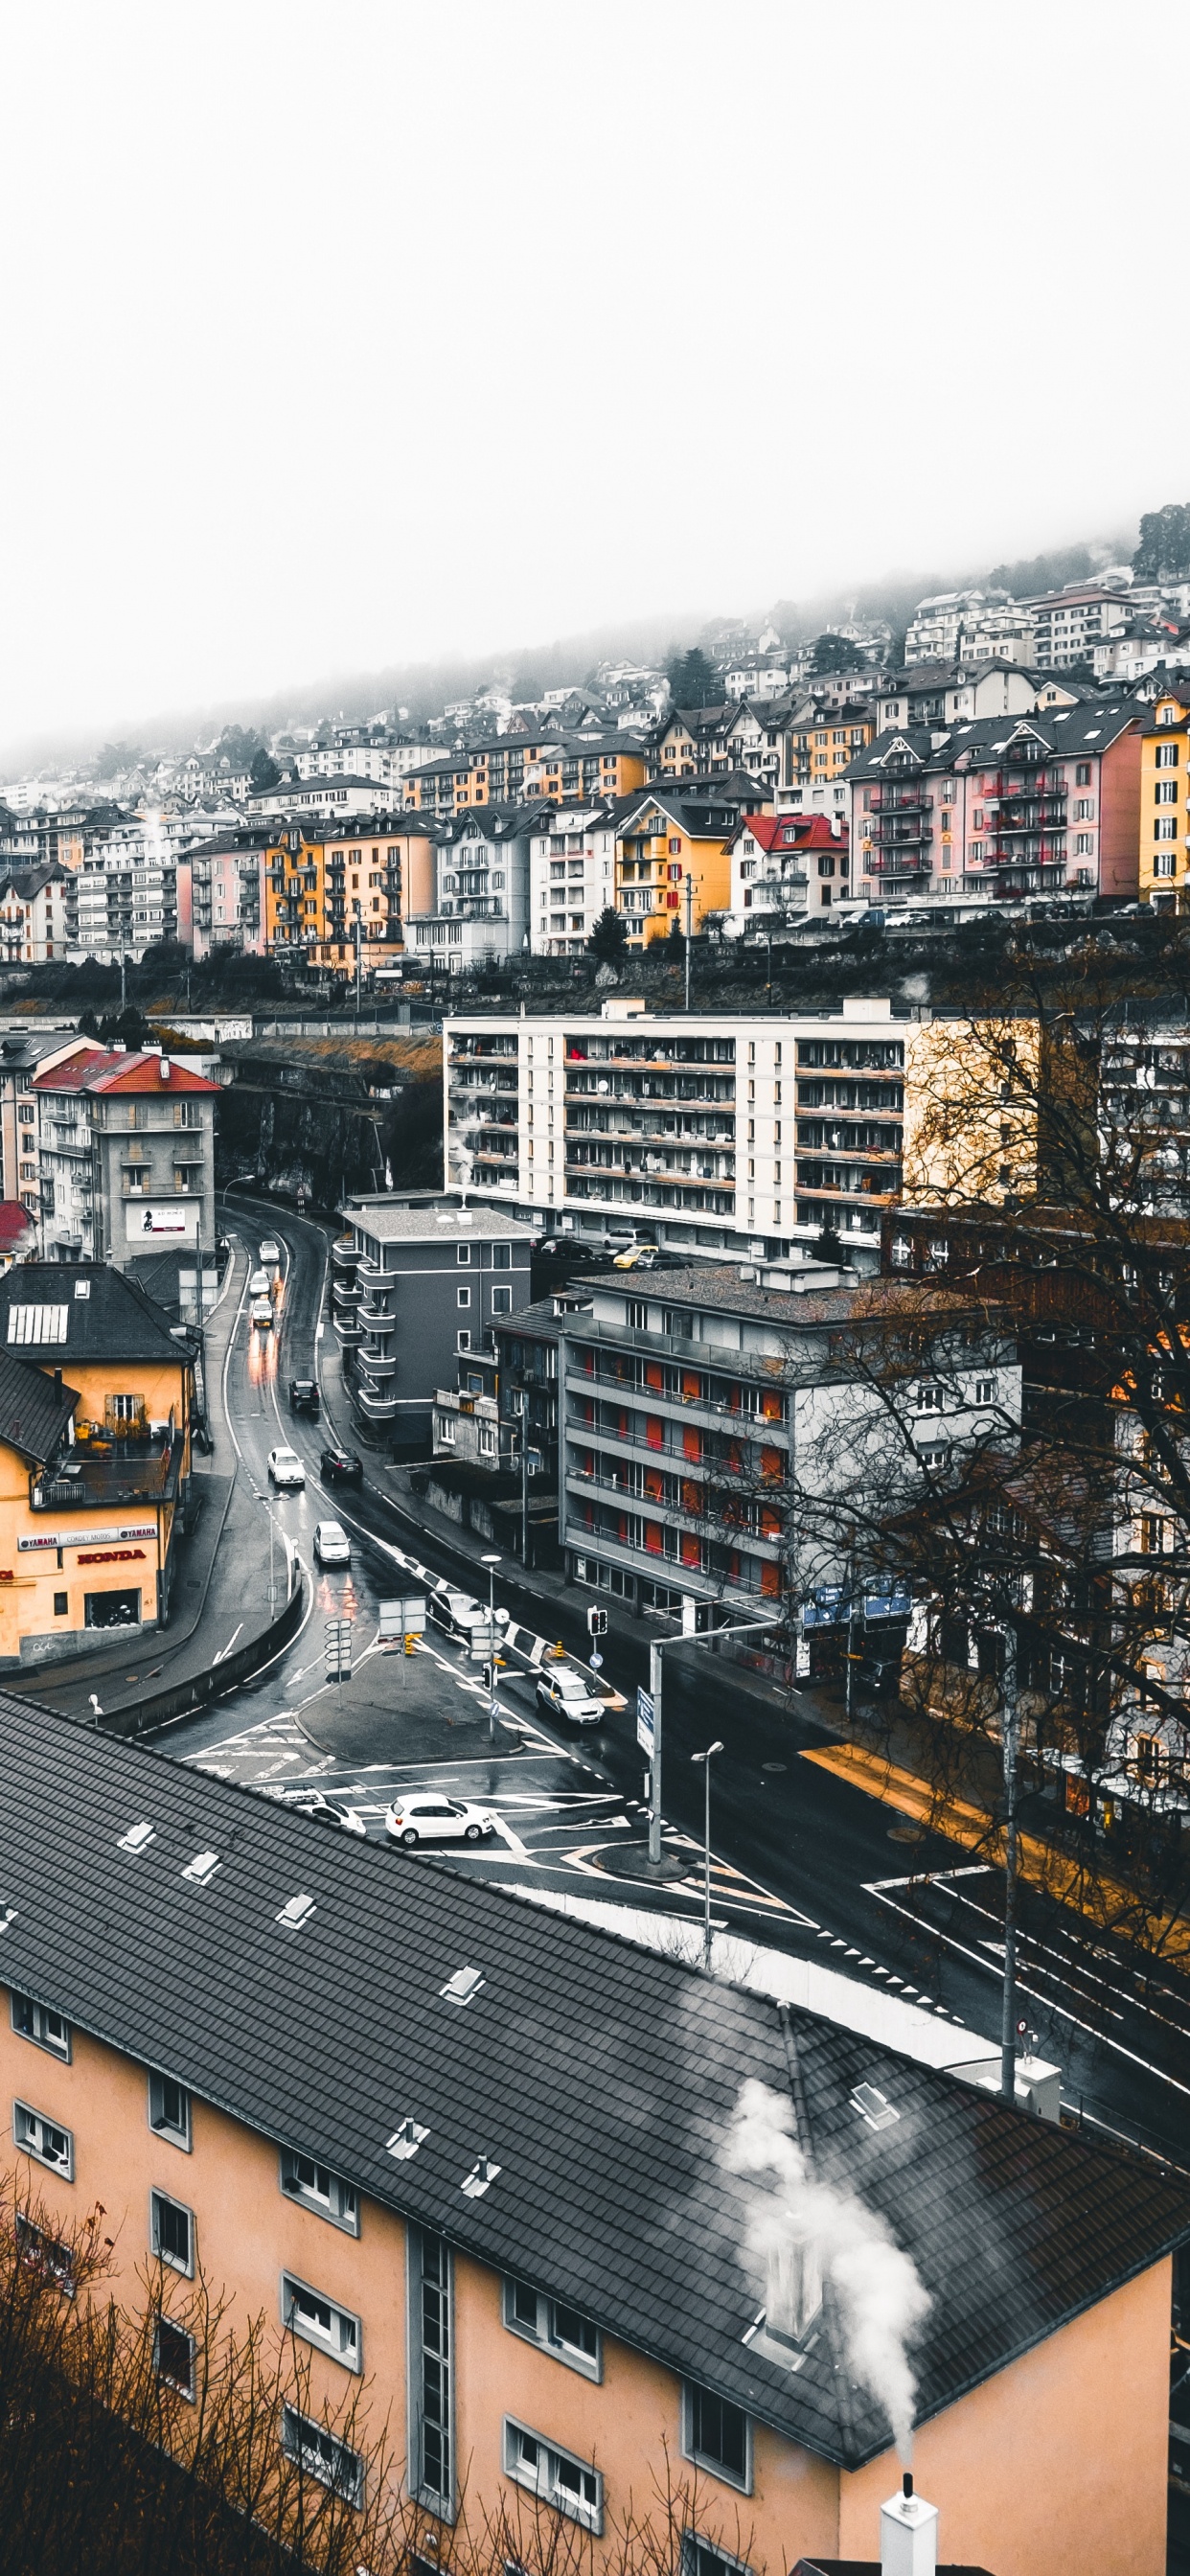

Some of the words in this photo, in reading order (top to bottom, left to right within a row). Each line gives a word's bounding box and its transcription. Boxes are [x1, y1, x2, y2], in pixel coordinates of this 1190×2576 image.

[127, 1528, 156, 1537] YAMAHA
[29, 1537, 57, 1547] YAMAHA
[78, 1549, 147, 1565] HONDA
